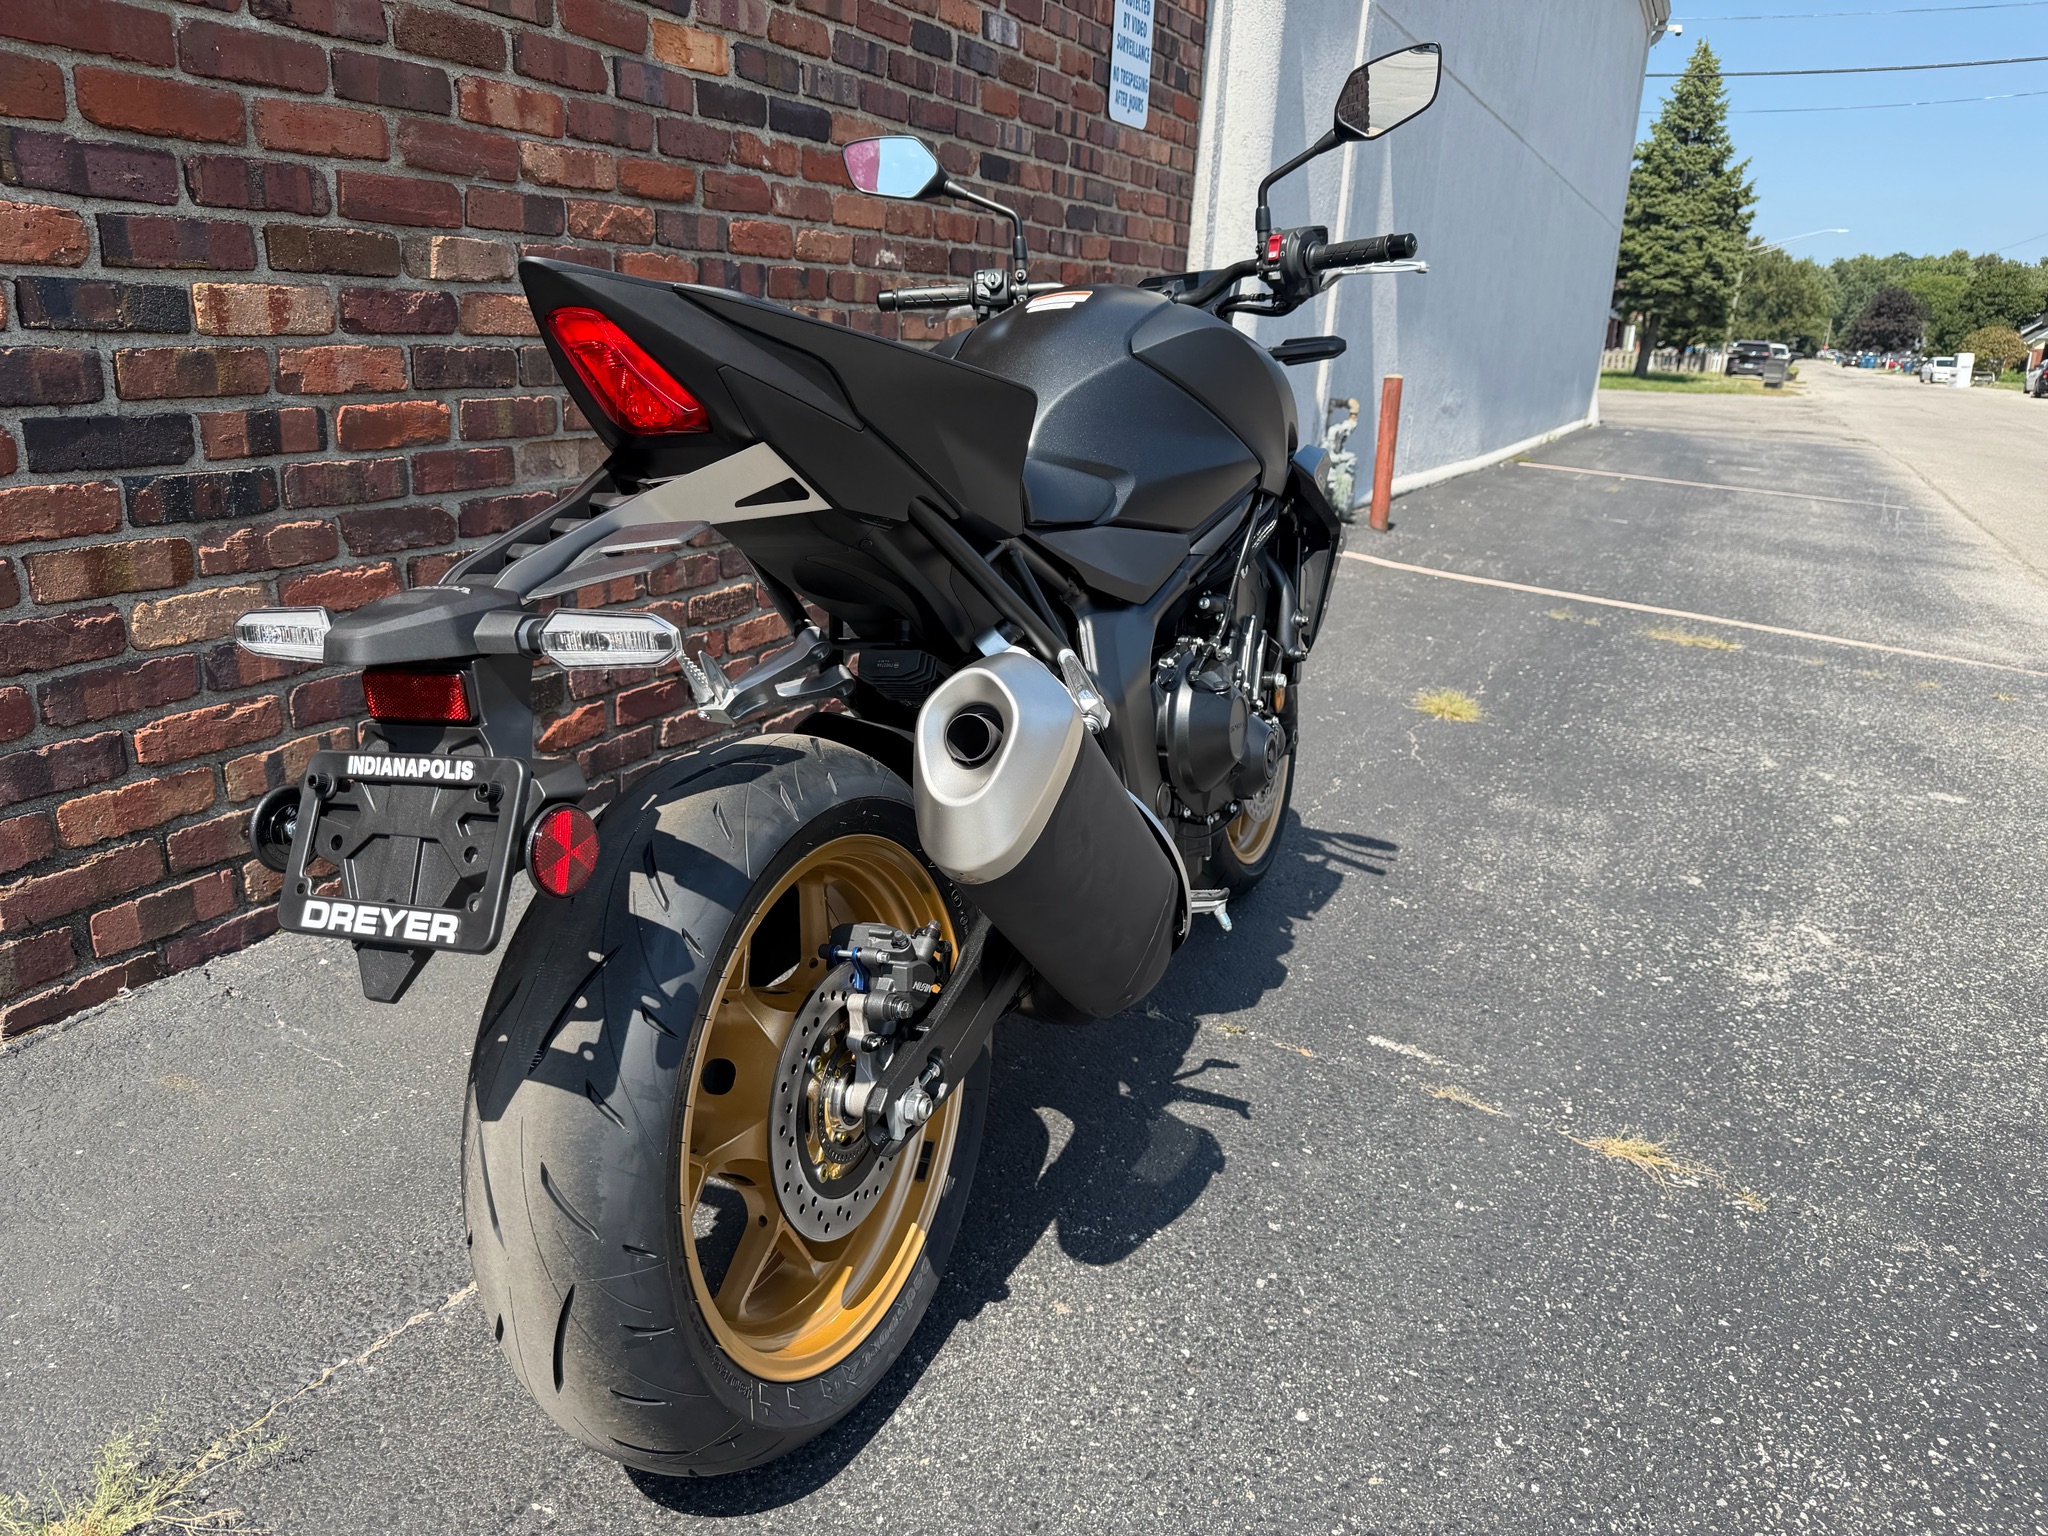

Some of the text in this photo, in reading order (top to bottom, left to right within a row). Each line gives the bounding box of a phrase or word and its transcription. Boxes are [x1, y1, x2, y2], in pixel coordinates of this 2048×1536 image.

[1123, 11, 1147, 38] BY VIDEO
[1116, 32, 1150, 63] SURVEILLANCE
[1112, 65, 1148, 93] NO TRESPASSING
[1115, 89, 1144, 114] AFTER HOURS
[347, 755, 476, 781] INDIANAPOLIS
[301, 899, 460, 944] DREYER
